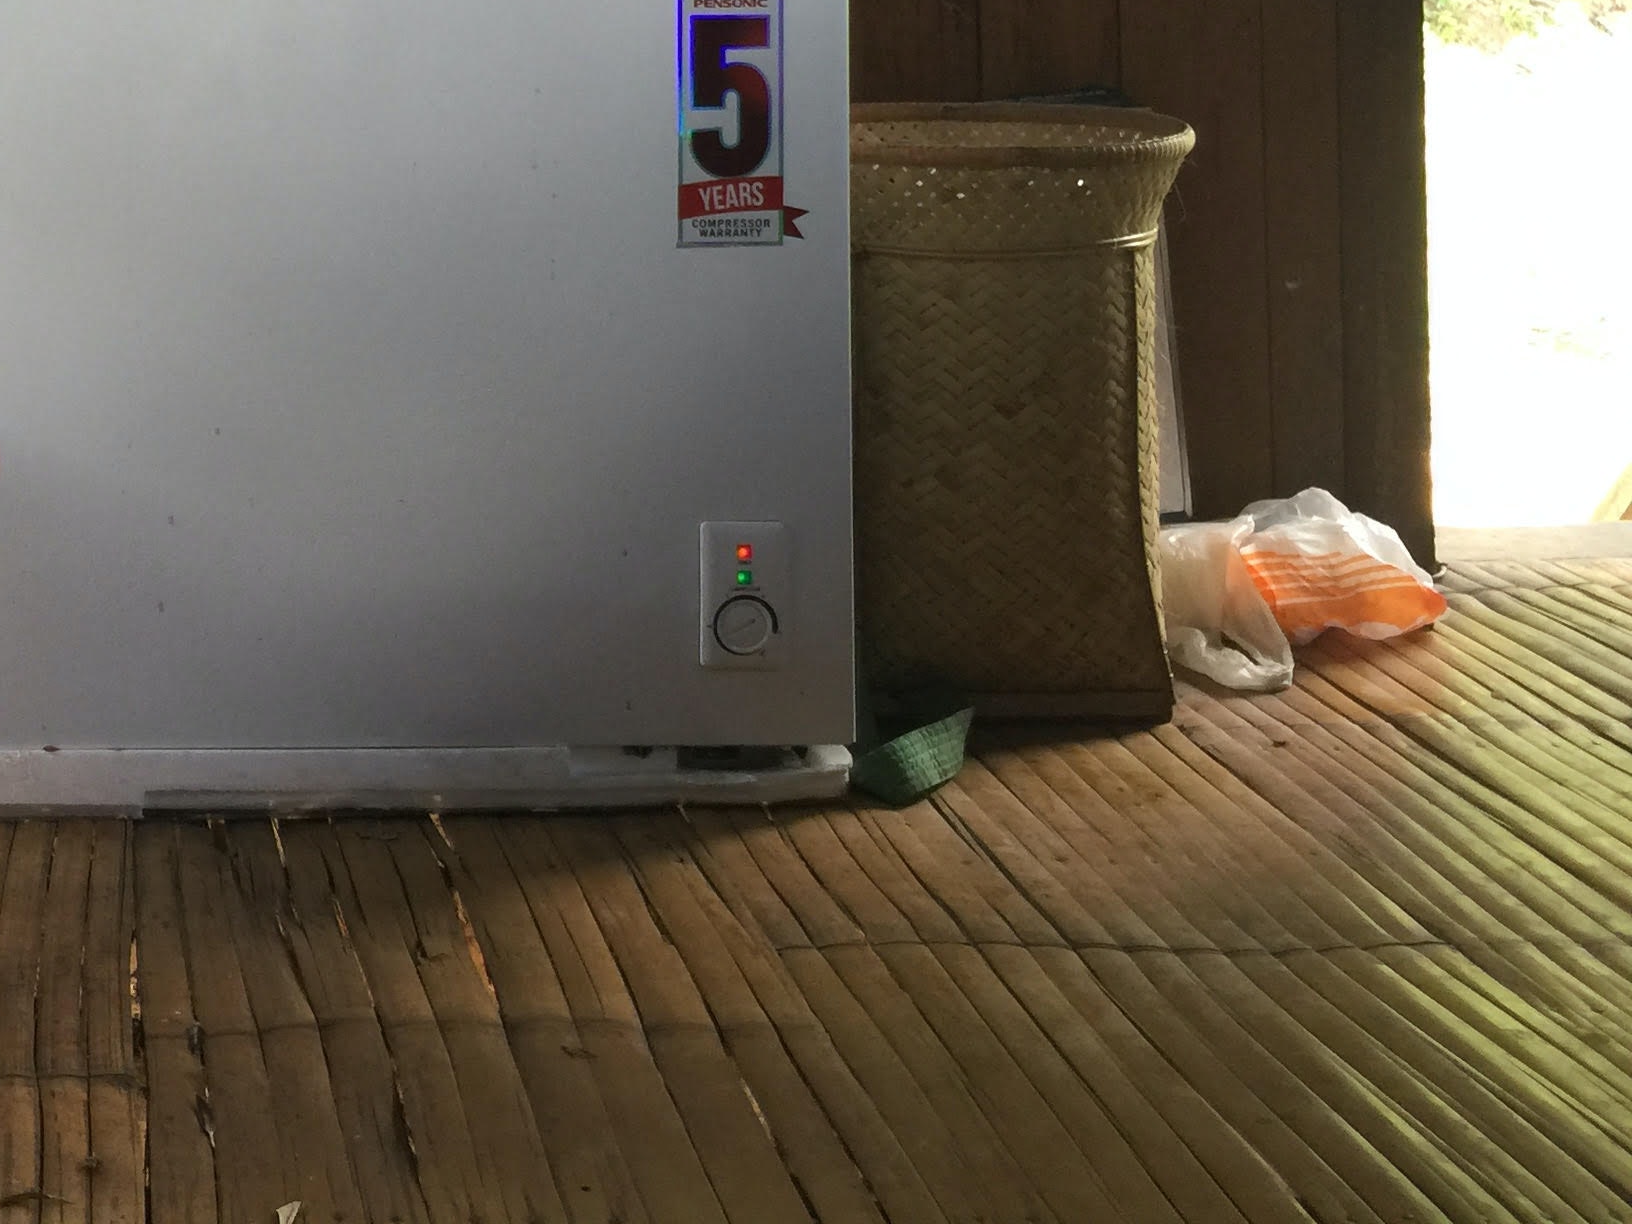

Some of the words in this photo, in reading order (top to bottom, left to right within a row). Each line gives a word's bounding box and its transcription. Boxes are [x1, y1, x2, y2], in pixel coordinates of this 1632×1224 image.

[689, 14, 771, 178] 5
[698, 181, 764, 211] YEARS
[691, 218, 771, 229] COMPRESSOR
[698, 228, 763, 238] WARRANTY
